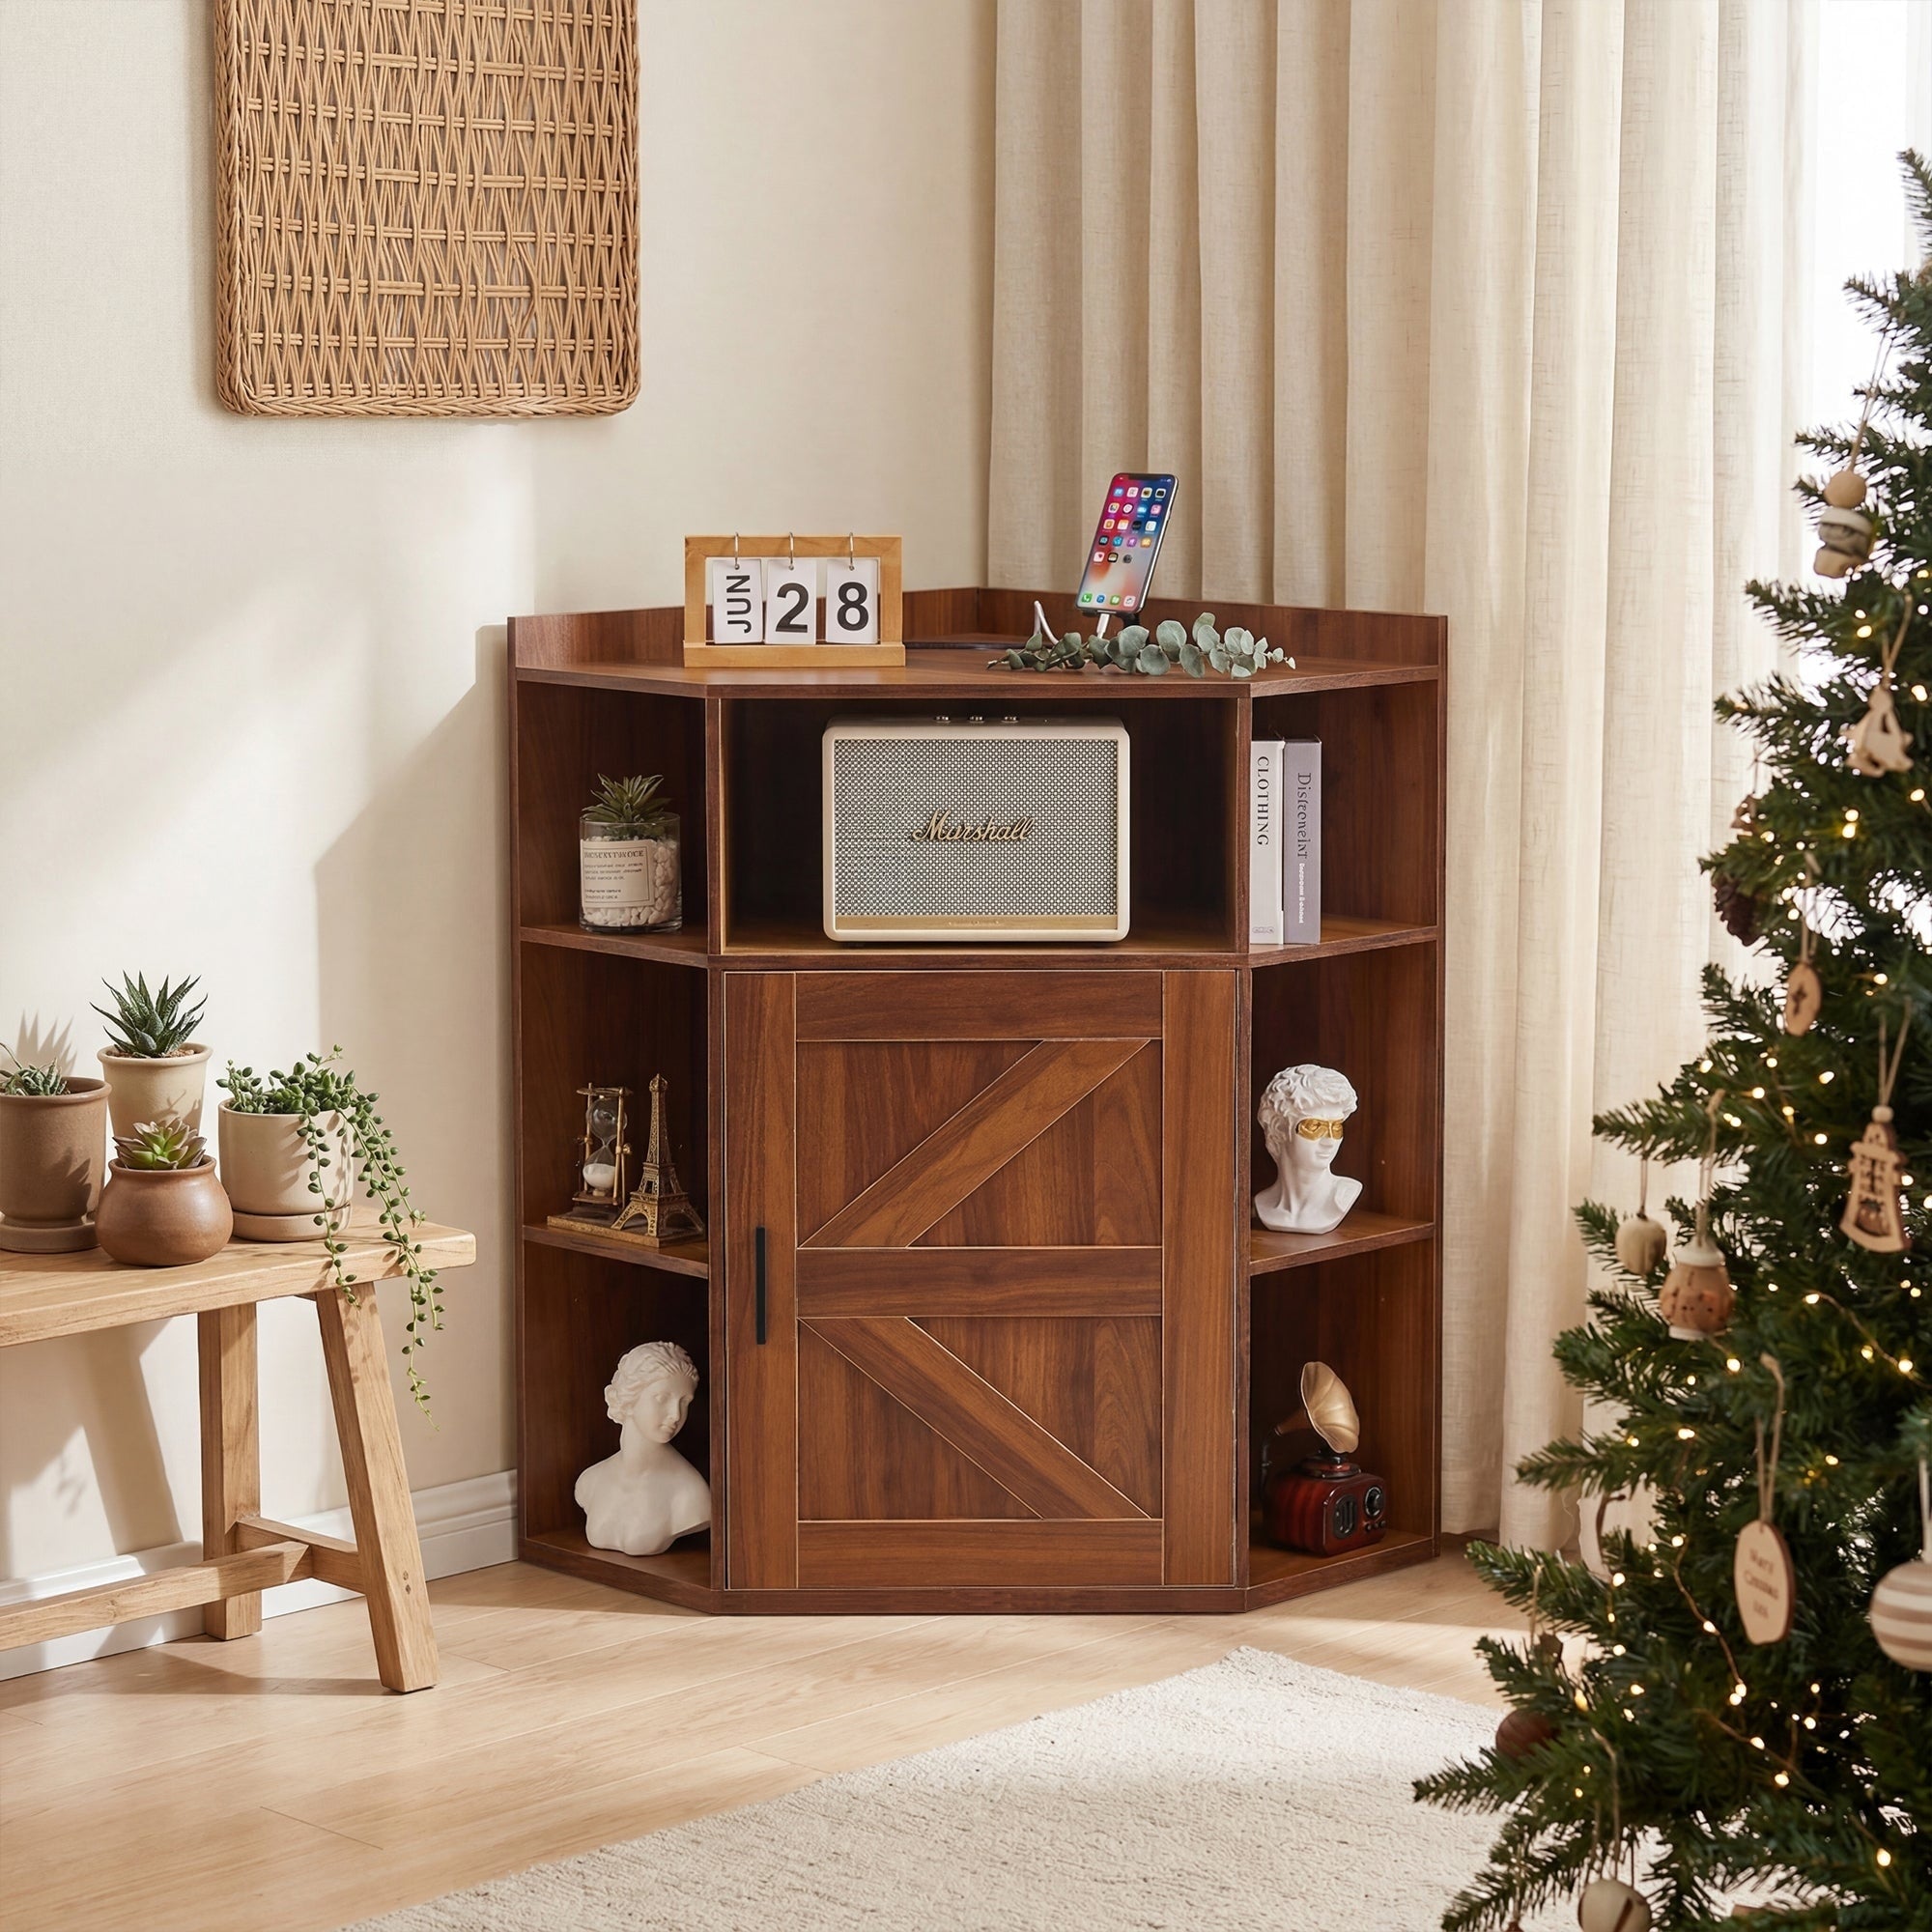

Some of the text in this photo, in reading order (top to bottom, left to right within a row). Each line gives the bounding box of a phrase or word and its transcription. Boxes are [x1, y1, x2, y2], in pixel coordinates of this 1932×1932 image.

[725, 575, 752, 634] JUN
[912, 808, 1036, 841] Marshall
[1257, 755, 1269, 846] CLOTHING
